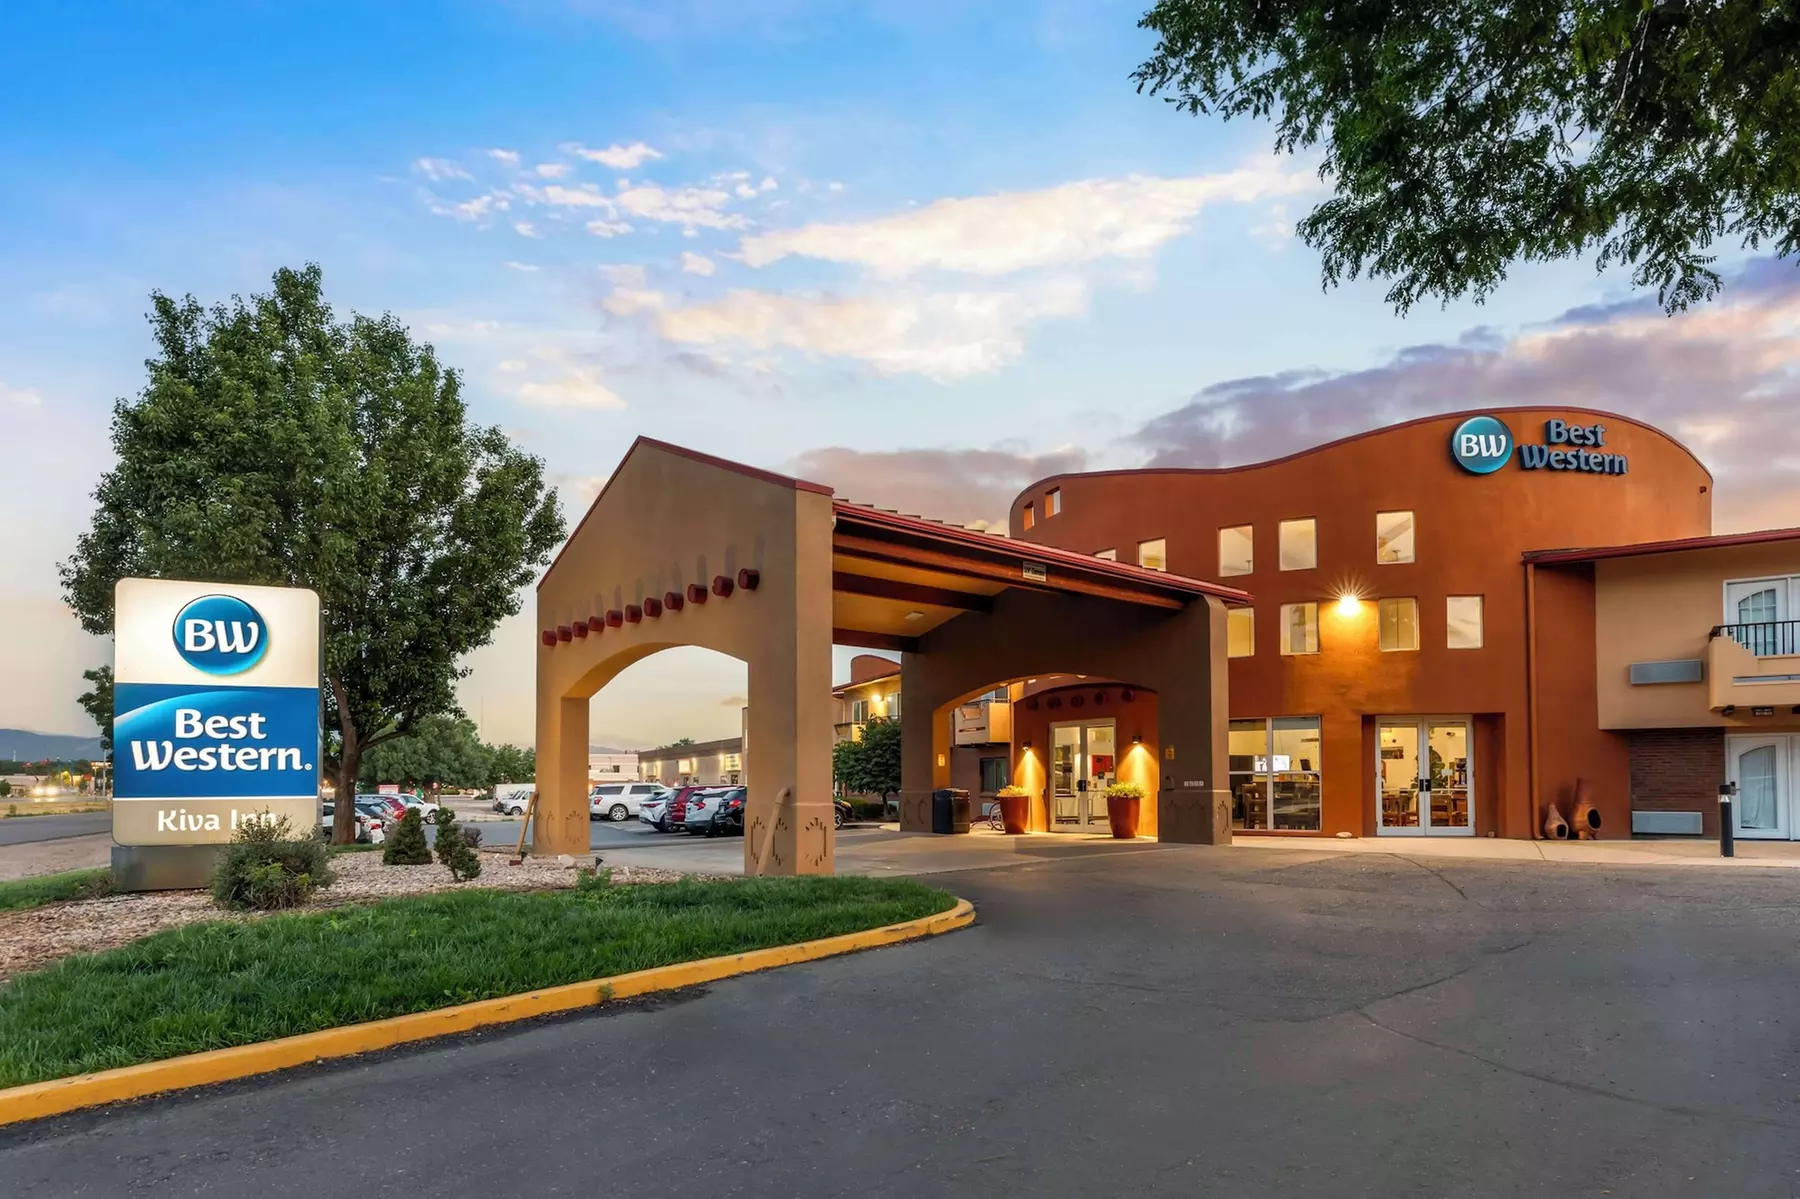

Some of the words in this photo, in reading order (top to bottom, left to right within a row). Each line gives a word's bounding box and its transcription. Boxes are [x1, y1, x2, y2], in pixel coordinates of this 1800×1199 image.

[1461, 434, 1507, 458] BW
[1547, 418, 1607, 446] Best
[1519, 444, 1628, 474] Western
[185, 619, 259, 653] BW
[175, 709, 267, 738] Best
[158, 809, 220, 831] Kiva
